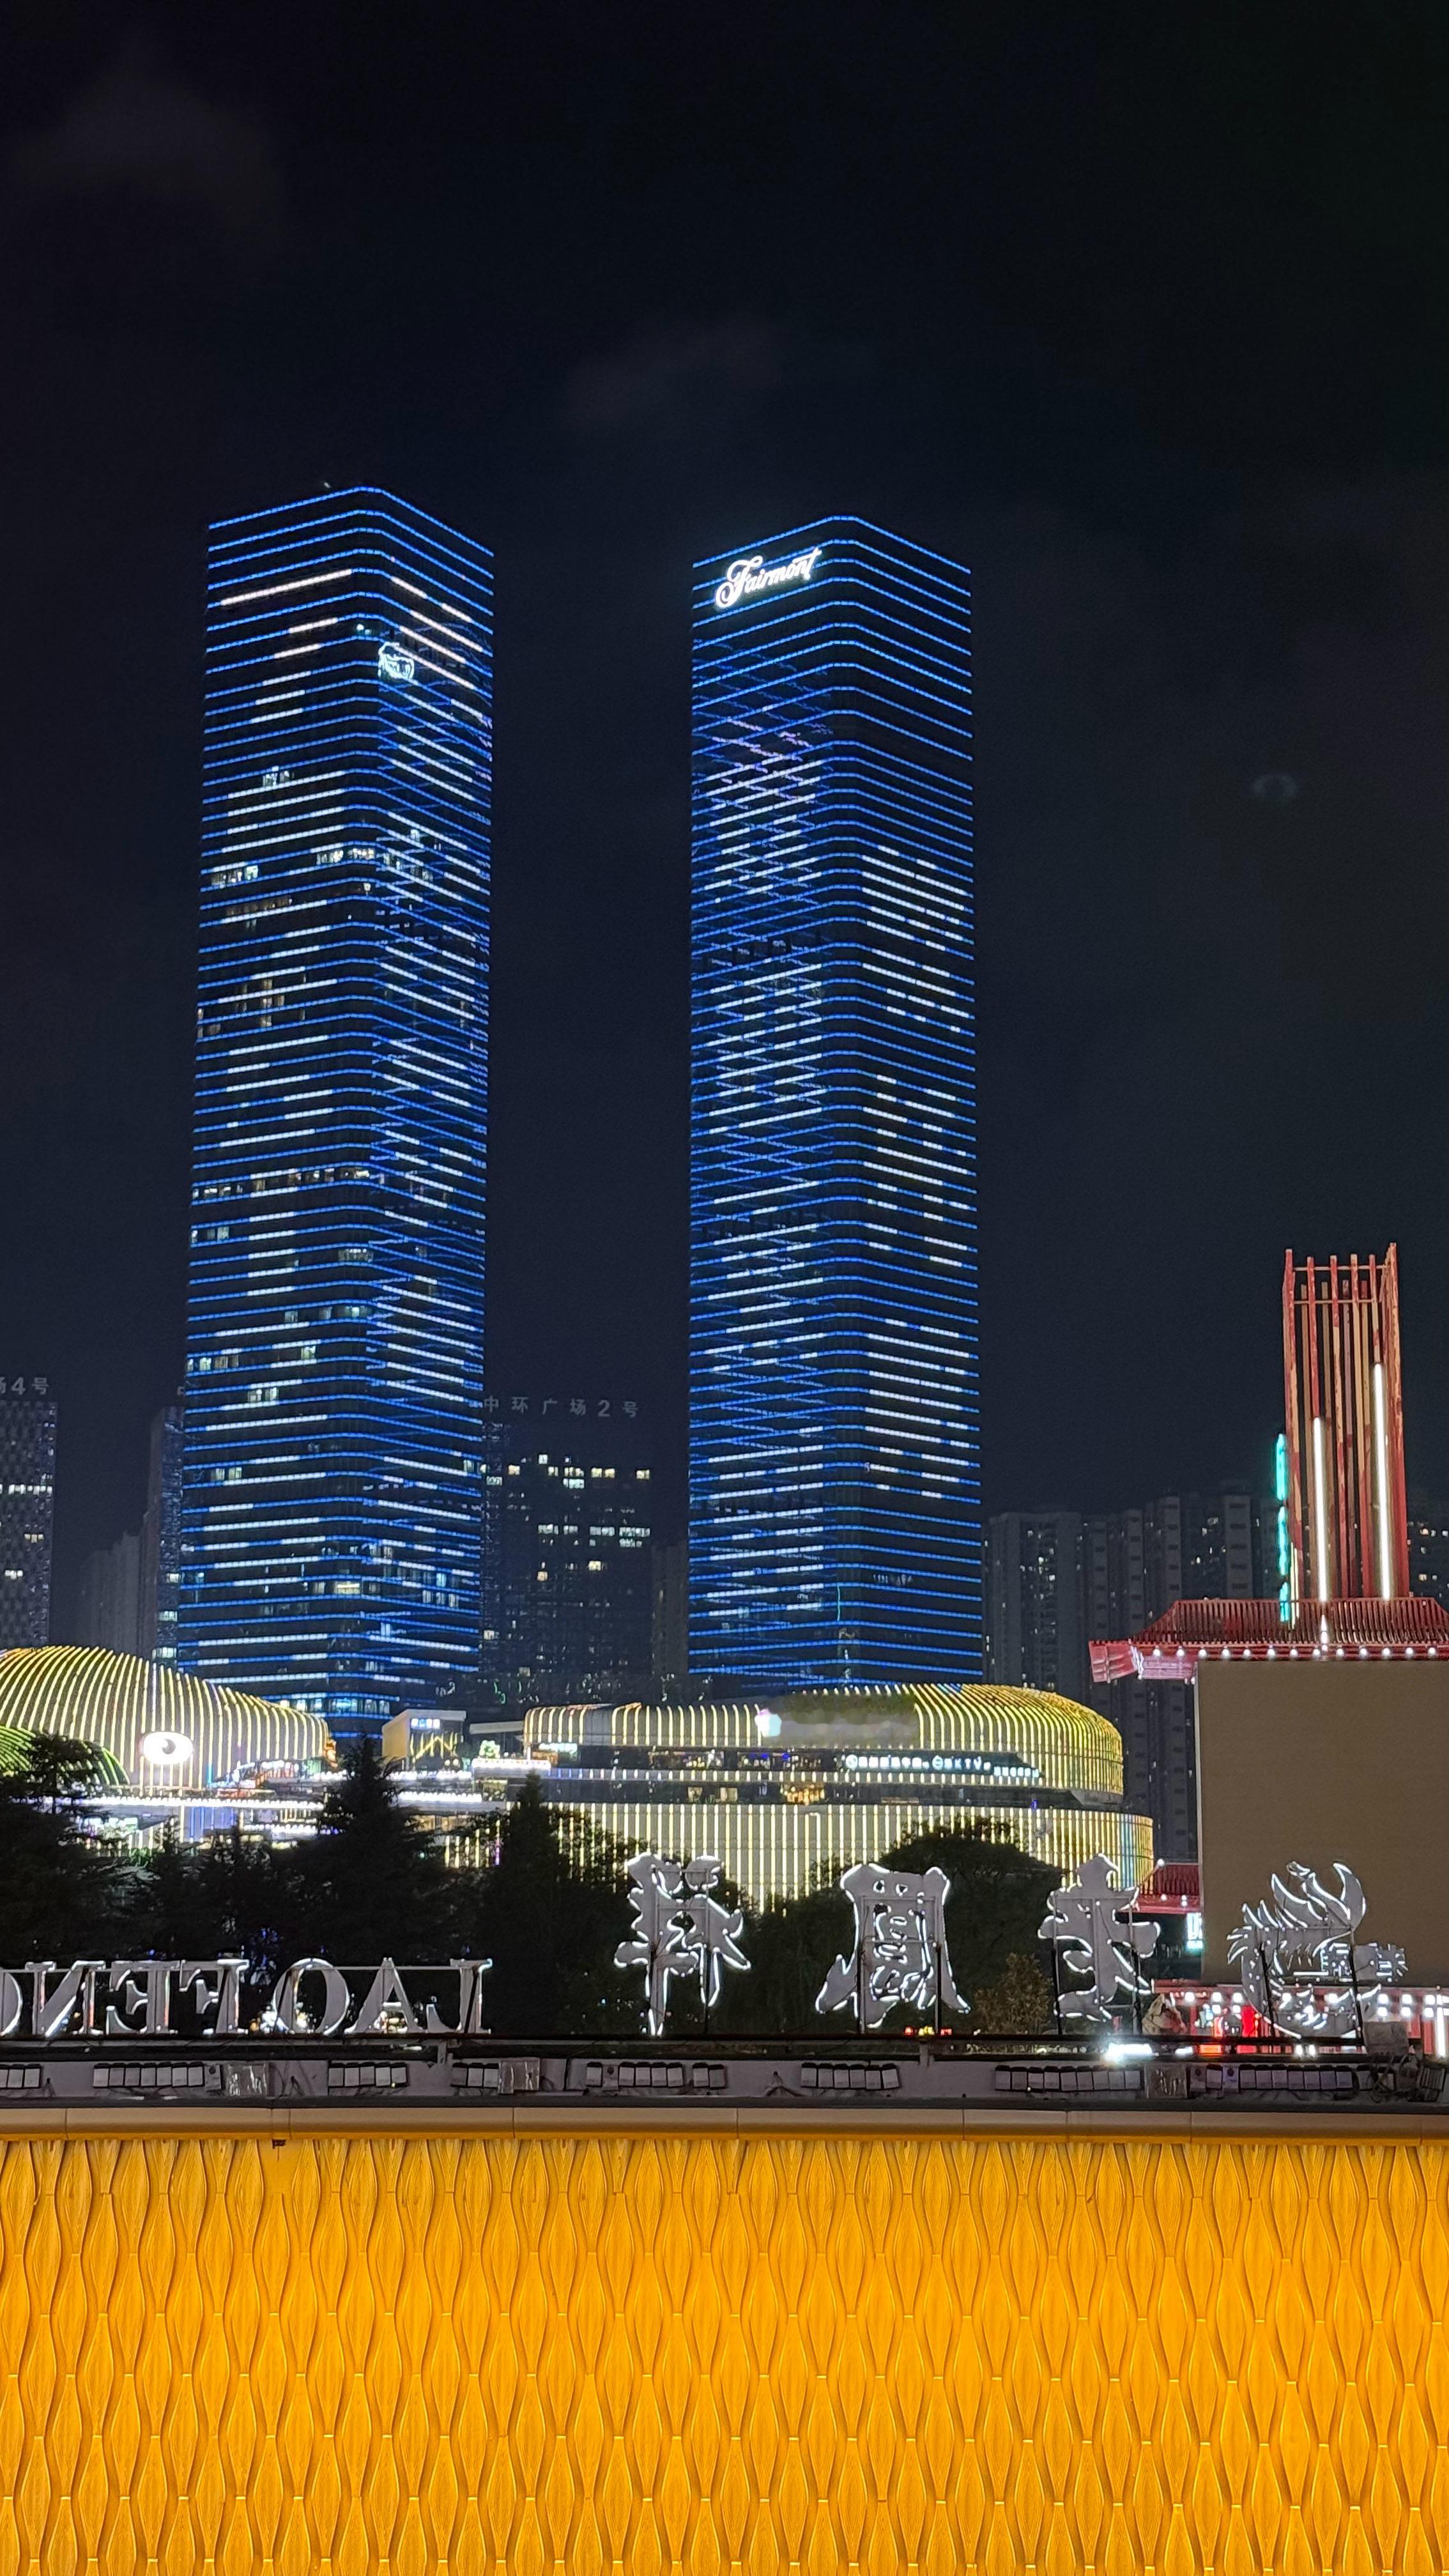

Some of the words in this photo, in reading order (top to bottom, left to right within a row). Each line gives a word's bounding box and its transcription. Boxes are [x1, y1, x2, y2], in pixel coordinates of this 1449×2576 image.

[716, 548, 822, 608] Fairmont
[484, 1395, 638, 1418] 中环广场2号
